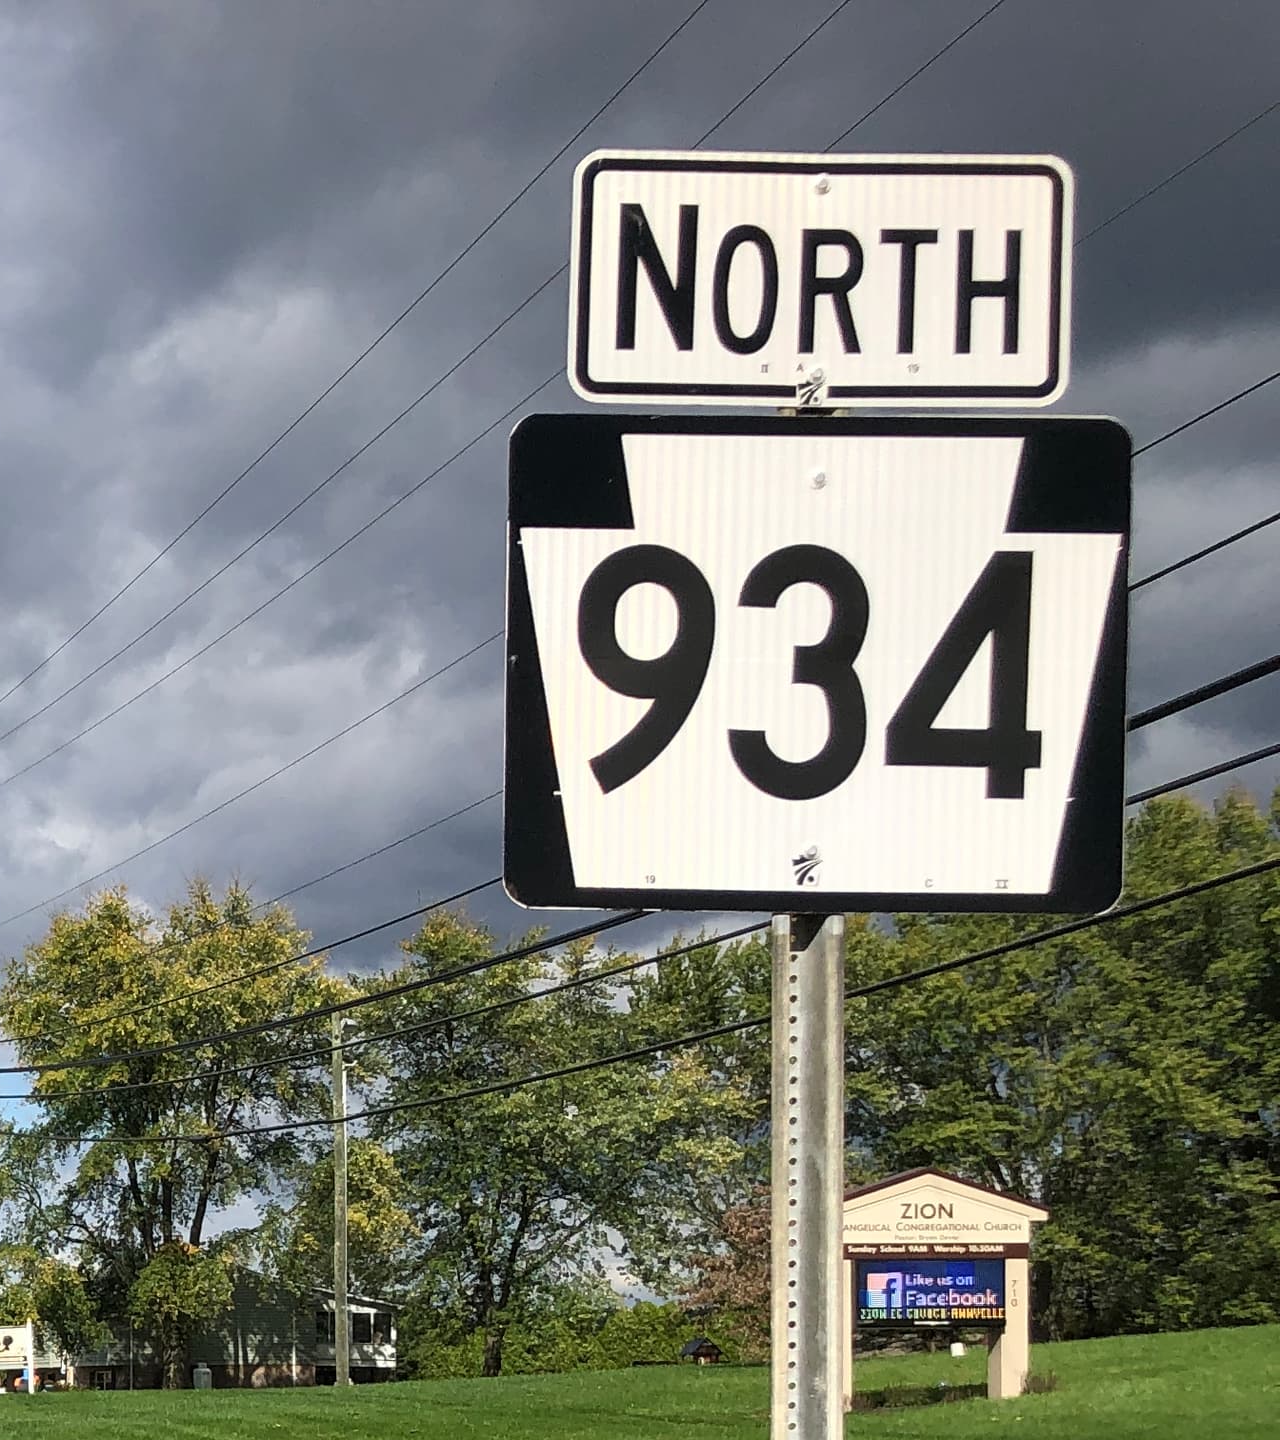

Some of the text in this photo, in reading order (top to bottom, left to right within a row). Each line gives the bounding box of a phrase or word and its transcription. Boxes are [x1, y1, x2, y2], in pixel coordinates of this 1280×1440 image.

[615, 203, 1023, 354] NORTH
[577, 543, 1043, 801] 934
[900, 1203, 954, 1219] ZION
[843, 1223, 891, 1232] ANGELICAL
[905, 1273, 973, 1286] Like us on
[906, 1288, 998, 1306] Facebook
